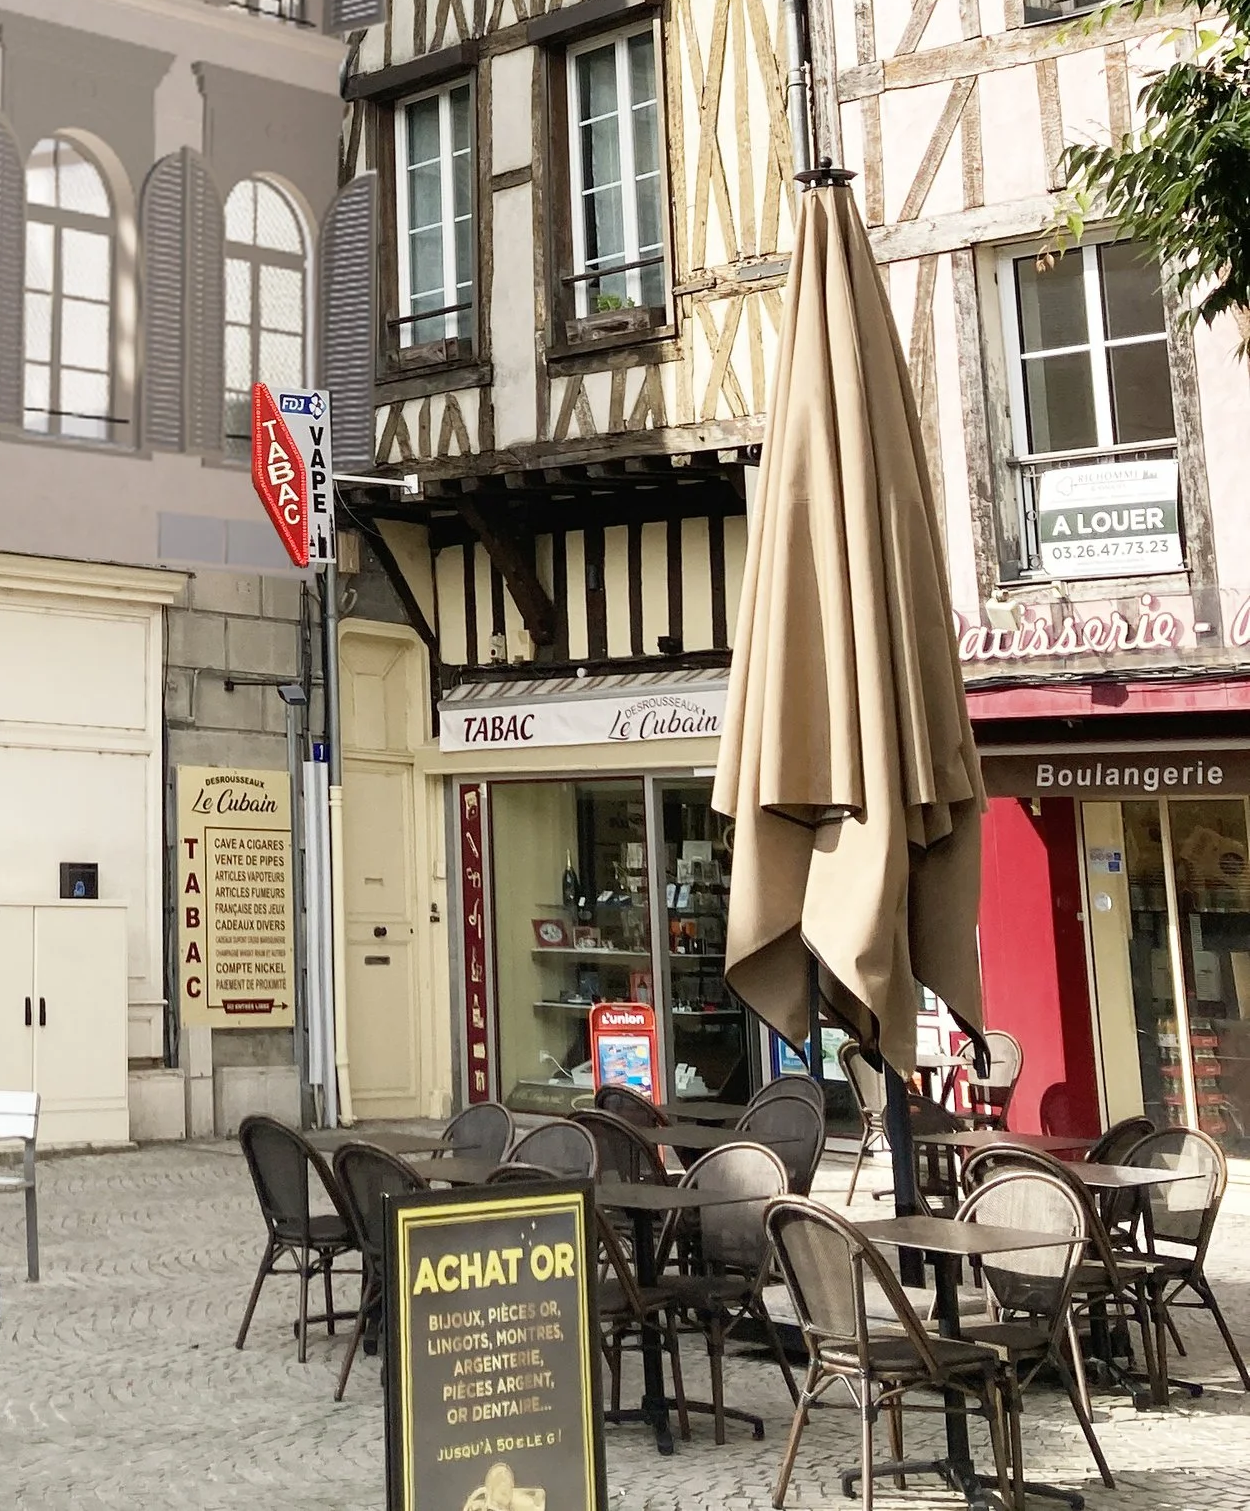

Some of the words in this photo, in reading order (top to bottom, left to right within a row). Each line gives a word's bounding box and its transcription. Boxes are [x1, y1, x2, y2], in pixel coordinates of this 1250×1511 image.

[281, 397, 305, 412] FDJ
[262, 419, 301, 526] TABAC
[309, 425, 327, 514] VAPE
[1052, 515, 1072, 536] A
[1077, 507, 1165, 535] LOUER
[1052, 539, 1169, 560] 03.26.47.73.23
[952, 593, 1177, 660] atisserie
[624, 696, 701, 719] DESROUSSEAUX
[463, 713, 535, 743] TABAC
[607, 709, 633, 741] Le
[638, 708, 720, 740] Cubain
[205, 775, 265, 789] DESROUSSEAUX
[1036, 760, 1224, 792] Boulangerie
[191, 788, 213, 815] Le
[216, 789, 279, 815] Cubain
[214, 838, 237, 850] CAVE
[238, 839, 245, 850] A
[246, 839, 285, 851] CIGARES
[215, 854, 244, 866] VENTE
[245, 855, 258, 866] DE
[259, 855, 285, 867] PIPES
[215, 871, 246, 882] ARTICLES
[247, 871, 285, 883] VAPOTEURS
[215, 887, 250, 898] ARTICLES
[251, 888, 285, 899] FUMEURS
[183, 837, 202, 999] TABAC
[214, 903, 253, 916] FRANÇAISE
[253, 903, 267, 915] DES
[268, 903, 285, 915] JEUX
[215, 919, 255, 931] CADEAUX
[256, 919, 286, 931] DIVERS
[215, 962, 253, 974] COMPTE
[254, 962, 286, 974] NICKEL
[215, 978, 245, 990] PAIEMENT
[246, 978, 255, 990] DE
[601, 1011, 645, 1025] L'union
[412, 1247, 524, 1296] ACHAT
[529, 1242, 575, 1282] OR
[428, 1309, 485, 1332] BIJOUX,
[488, 1301, 536, 1324] PIÈCES
[539, 1300, 562, 1317] OR,
[427, 1332, 493, 1356] LINGOTS,
[496, 1324, 564, 1347] MONTRES,
[453, 1349, 544, 1377] ARGENTERIE,
[442, 1379, 493, 1402] PIÈCES
[496, 1371, 555, 1395] ARGENT,
[446, 1405, 468, 1425] OR
